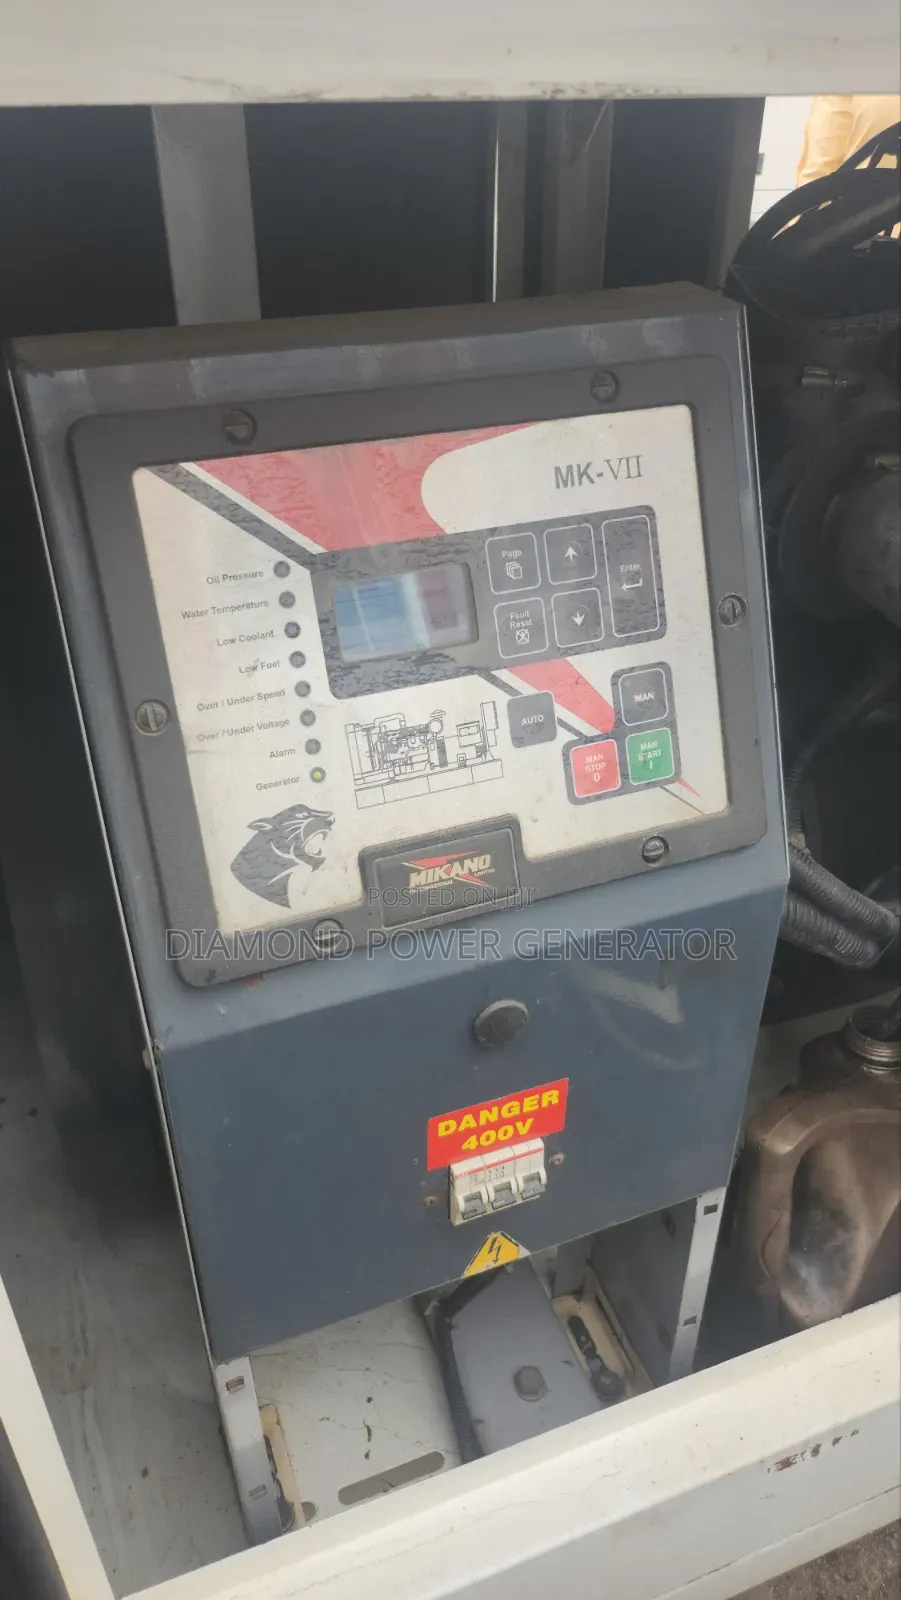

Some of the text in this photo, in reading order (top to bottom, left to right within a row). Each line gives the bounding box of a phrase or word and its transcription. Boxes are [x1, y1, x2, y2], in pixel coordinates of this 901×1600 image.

[553, 454, 644, 489] MK-VII
[501, 549, 523, 561] Page
[619, 563, 641, 573] Enter
[206, 570, 264, 585] Oil Pressure
[181, 599, 270, 620] Water Temperature
[509, 610, 530, 621] Fault
[509, 618, 533, 629] Reset
[217, 630, 275, 647] Low Coolant
[239, 659, 281, 674] Low Fuel
[196, 702, 219, 712] Over
[226, 695, 255, 706] Under
[256, 688, 286, 702] Speed
[634, 691, 655, 703] MAN
[521, 713, 545, 727] AUTO
[197, 730, 220, 742] Over
[226, 724, 255, 737] Under
[256, 718, 290, 731] Voltage
[639, 740, 659, 751] MAN
[269, 747, 296, 760] Alarm
[584, 753, 604, 765] MAN
[638, 749, 662, 762] START
[585, 761, 607, 773] STOP
[256, 776, 300, 791] Generator
[409, 854, 491, 889] MIKANO
[437, 1089, 560, 1137] DANGER
[461, 1117, 534, 1150] 400V
